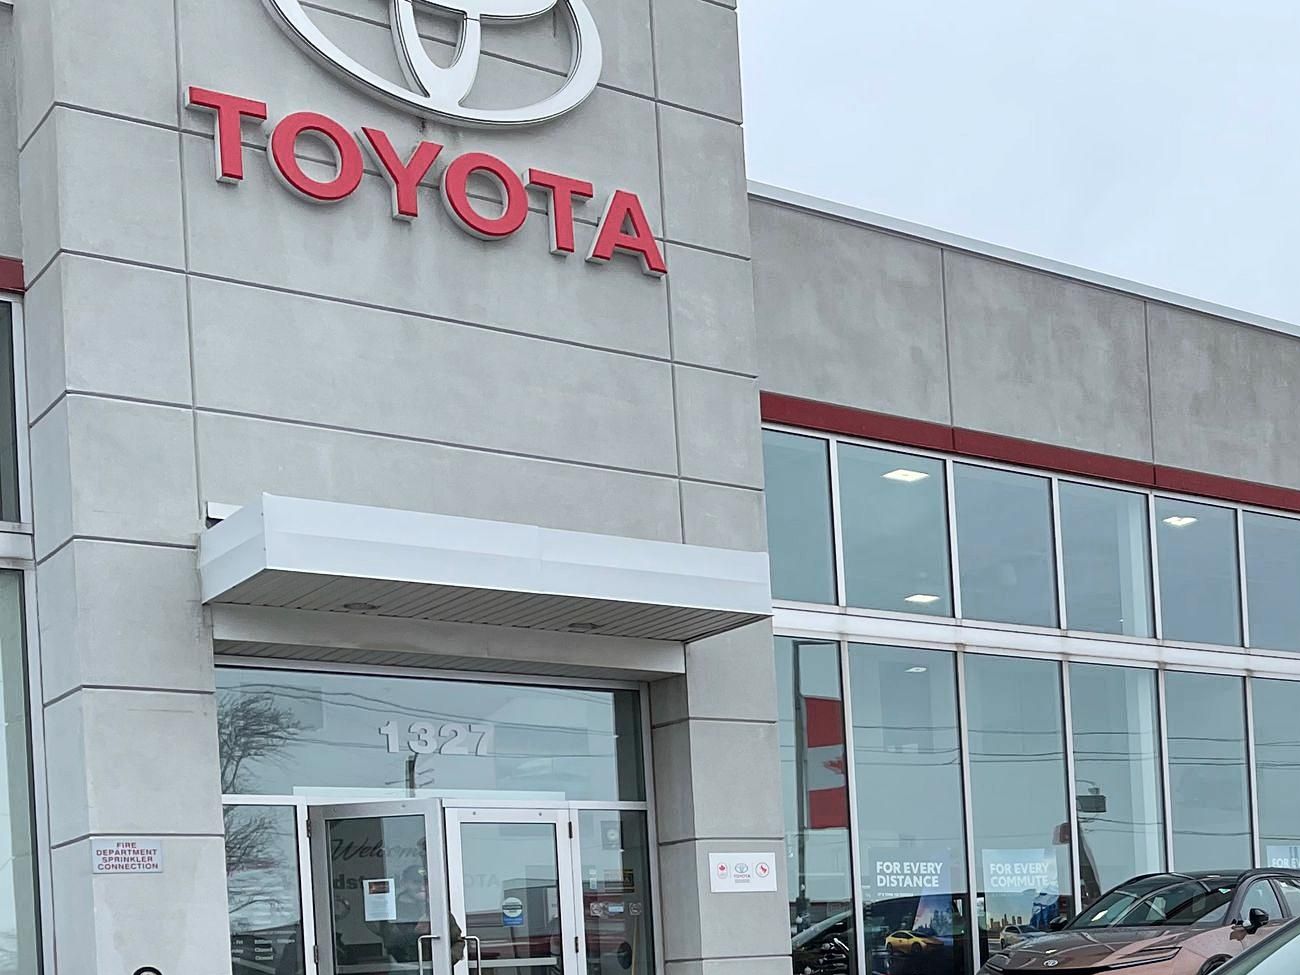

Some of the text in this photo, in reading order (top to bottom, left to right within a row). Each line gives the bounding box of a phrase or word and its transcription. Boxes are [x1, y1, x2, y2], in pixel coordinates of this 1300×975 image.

[186, 86, 668, 278] TOYOTA
[379, 720, 488, 756] 1327
[876, 861, 943, 875] FOR EVERY
[990, 863, 1049, 875] FOR EVERY
[877, 875, 939, 887] DISTANCE
[991, 875, 1049, 887] COMMUTE
